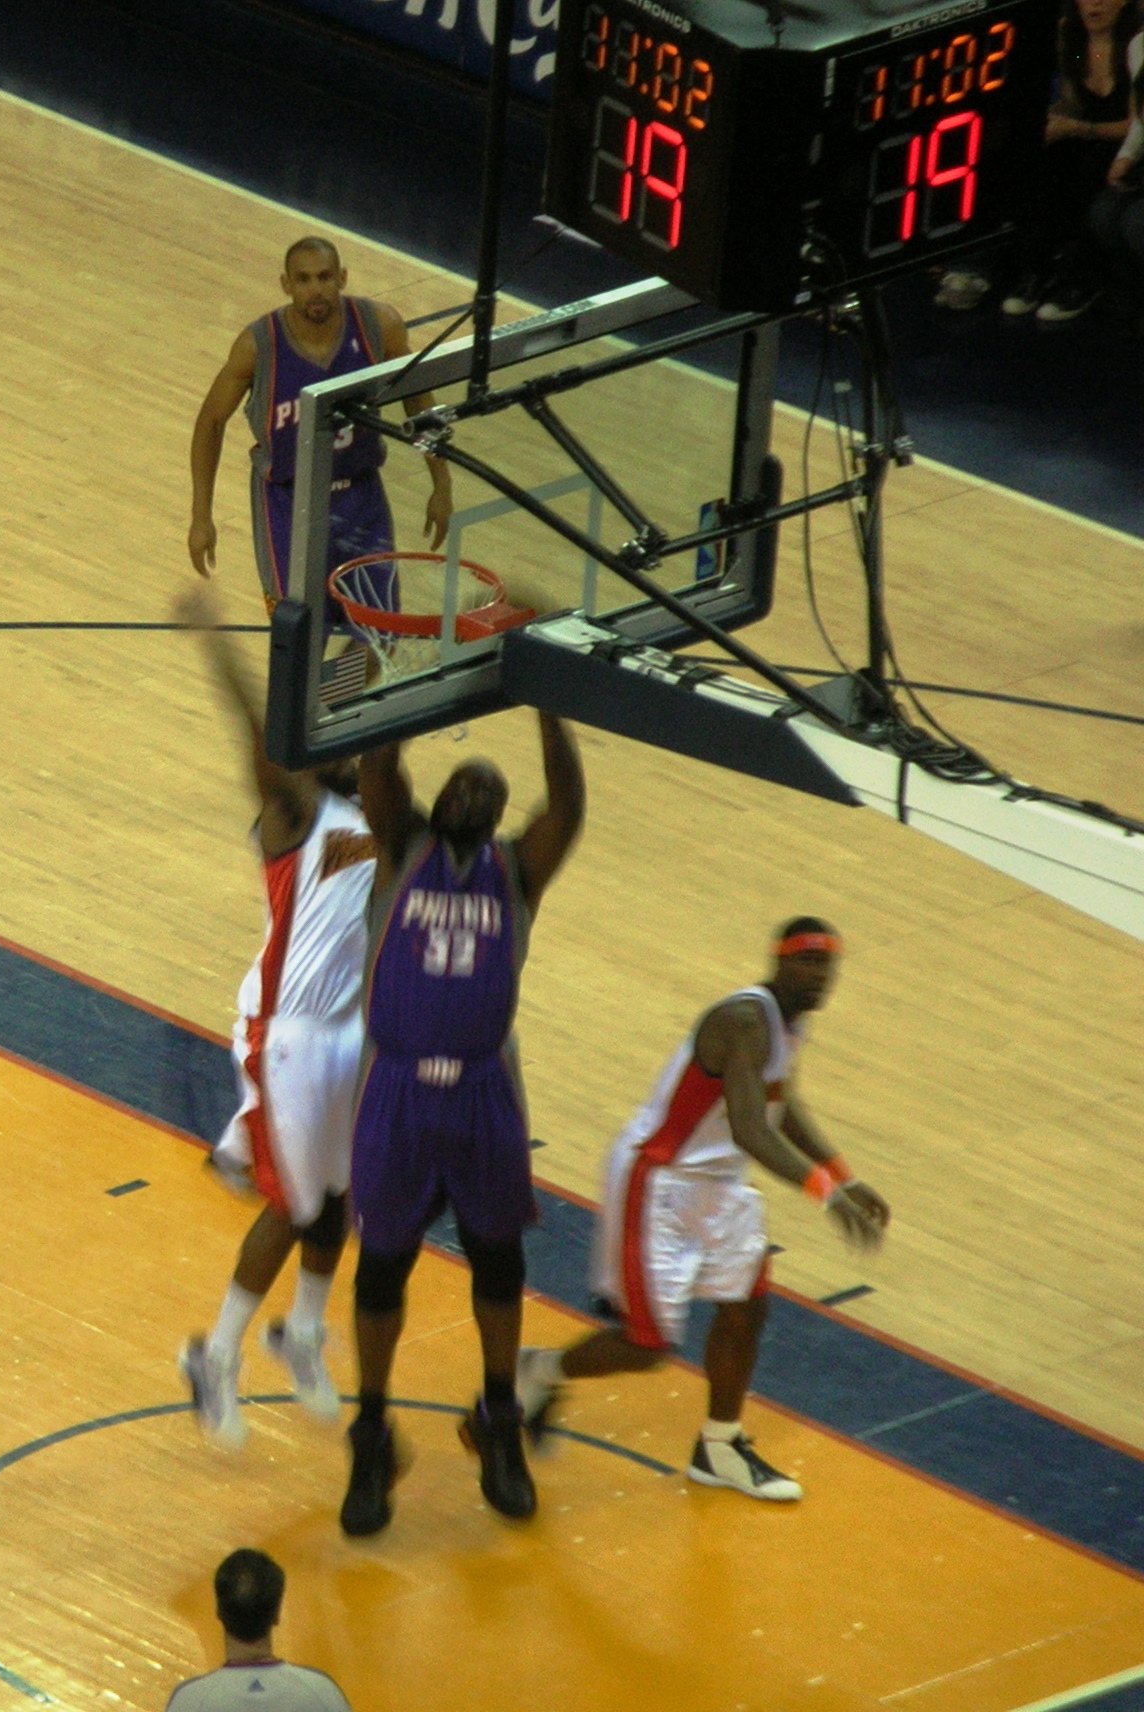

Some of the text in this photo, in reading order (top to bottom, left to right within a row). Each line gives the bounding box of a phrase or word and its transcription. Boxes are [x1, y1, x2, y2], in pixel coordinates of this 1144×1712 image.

[596, 14, 714, 130] 11:02
[872, 21, 1016, 122] 11:02
[890, 0, 987, 38] DAKTRONICS
[620, 115, 687, 249] 19
[900, 110, 983, 242] 19
